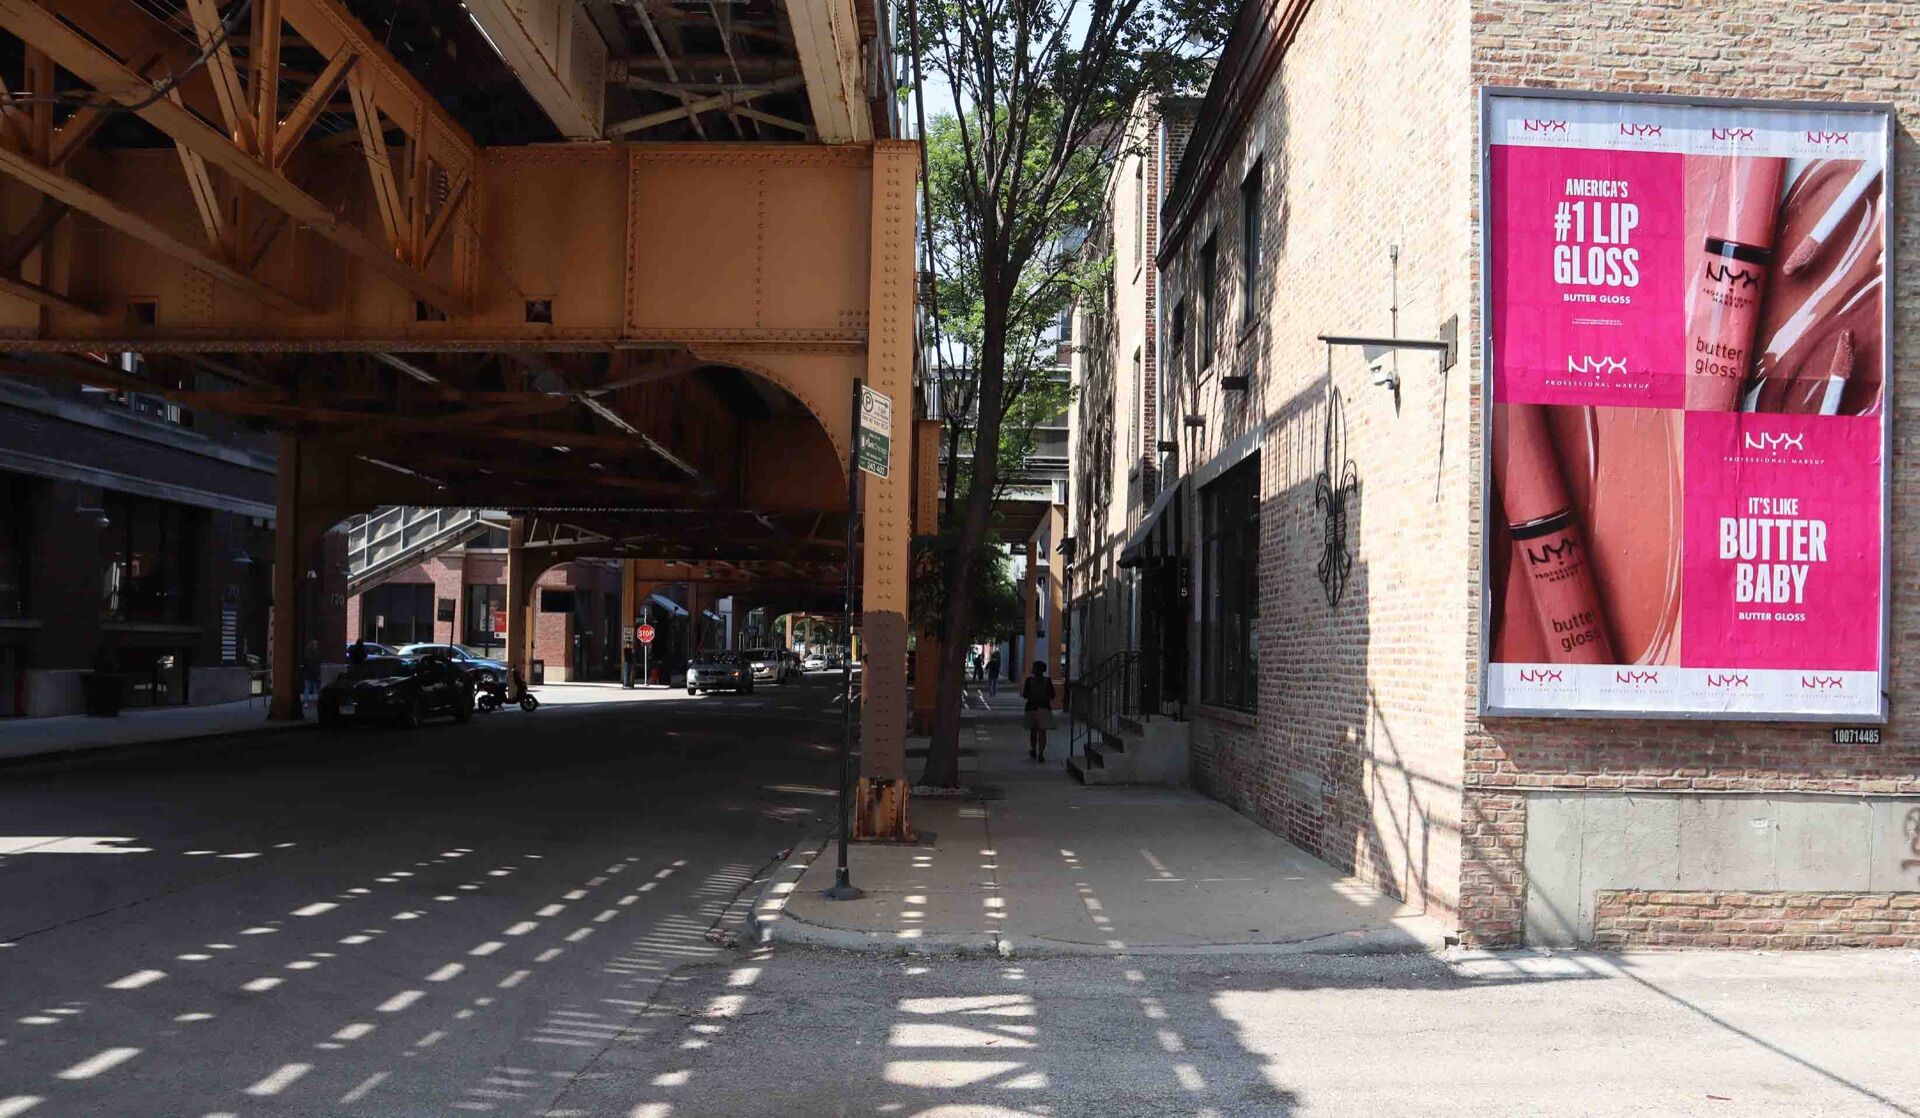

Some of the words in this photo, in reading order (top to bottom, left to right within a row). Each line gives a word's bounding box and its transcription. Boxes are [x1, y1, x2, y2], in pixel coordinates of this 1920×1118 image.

[1524, 119, 1566, 132] NYX
[1620, 123, 1662, 137] NYX
[1712, 128, 1753, 141] NYX
[1807, 131, 1848, 144] NYX
[1565, 178, 1629, 198] AMERICA'S
[1554, 201, 1585, 242] #1
[1593, 201, 1639, 245] LIP
[1553, 244, 1640, 287] GLOSS
[1705, 261, 1760, 289] NYX
[1563, 293, 1597, 302] BUTTER
[1599, 295, 1631, 304] GLOSS
[1696, 336, 1743, 360] butter
[1568, 355, 1627, 374] NYX
[1695, 357, 1737, 379] gloss
[1545, 380, 1610, 388] PROFESSIONAL
[1745, 431, 1804, 450] NYX
[1748, 497, 1770, 514] IT'S
[1772, 498, 1799, 515] LIKE
[1719, 517, 1827, 562] BUTTER
[1736, 563, 1809, 604] BABY
[1738, 612, 1771, 621] BUTTER
[1774, 612, 1806, 621] GLOSS
[1520, 670, 1562, 682] NYX
[1616, 671, 1658, 684] NYX
[1708, 674, 1748, 687] NYX
[1802, 676, 1843, 689] NYX
[1834, 729, 1880, 744] 100714485
